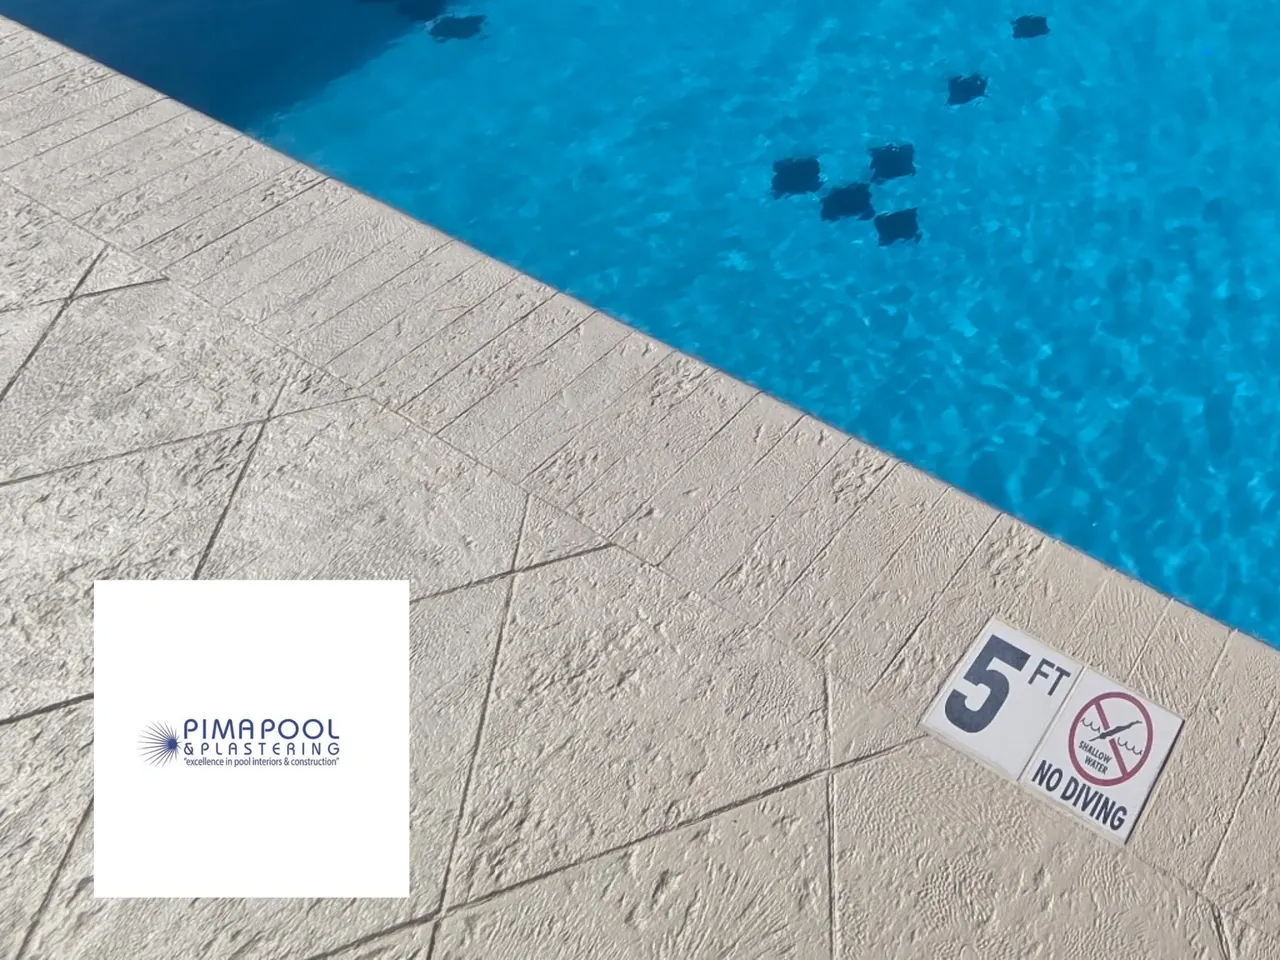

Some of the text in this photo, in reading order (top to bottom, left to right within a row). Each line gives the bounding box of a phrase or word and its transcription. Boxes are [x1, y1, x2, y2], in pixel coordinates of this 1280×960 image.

[945, 634, 1071, 733] 5 FT
[1078, 740, 1112, 764] SHALLOW
[1084, 755, 1108, 775] WATER
[1031, 760, 1127, 831] NO DIVING
